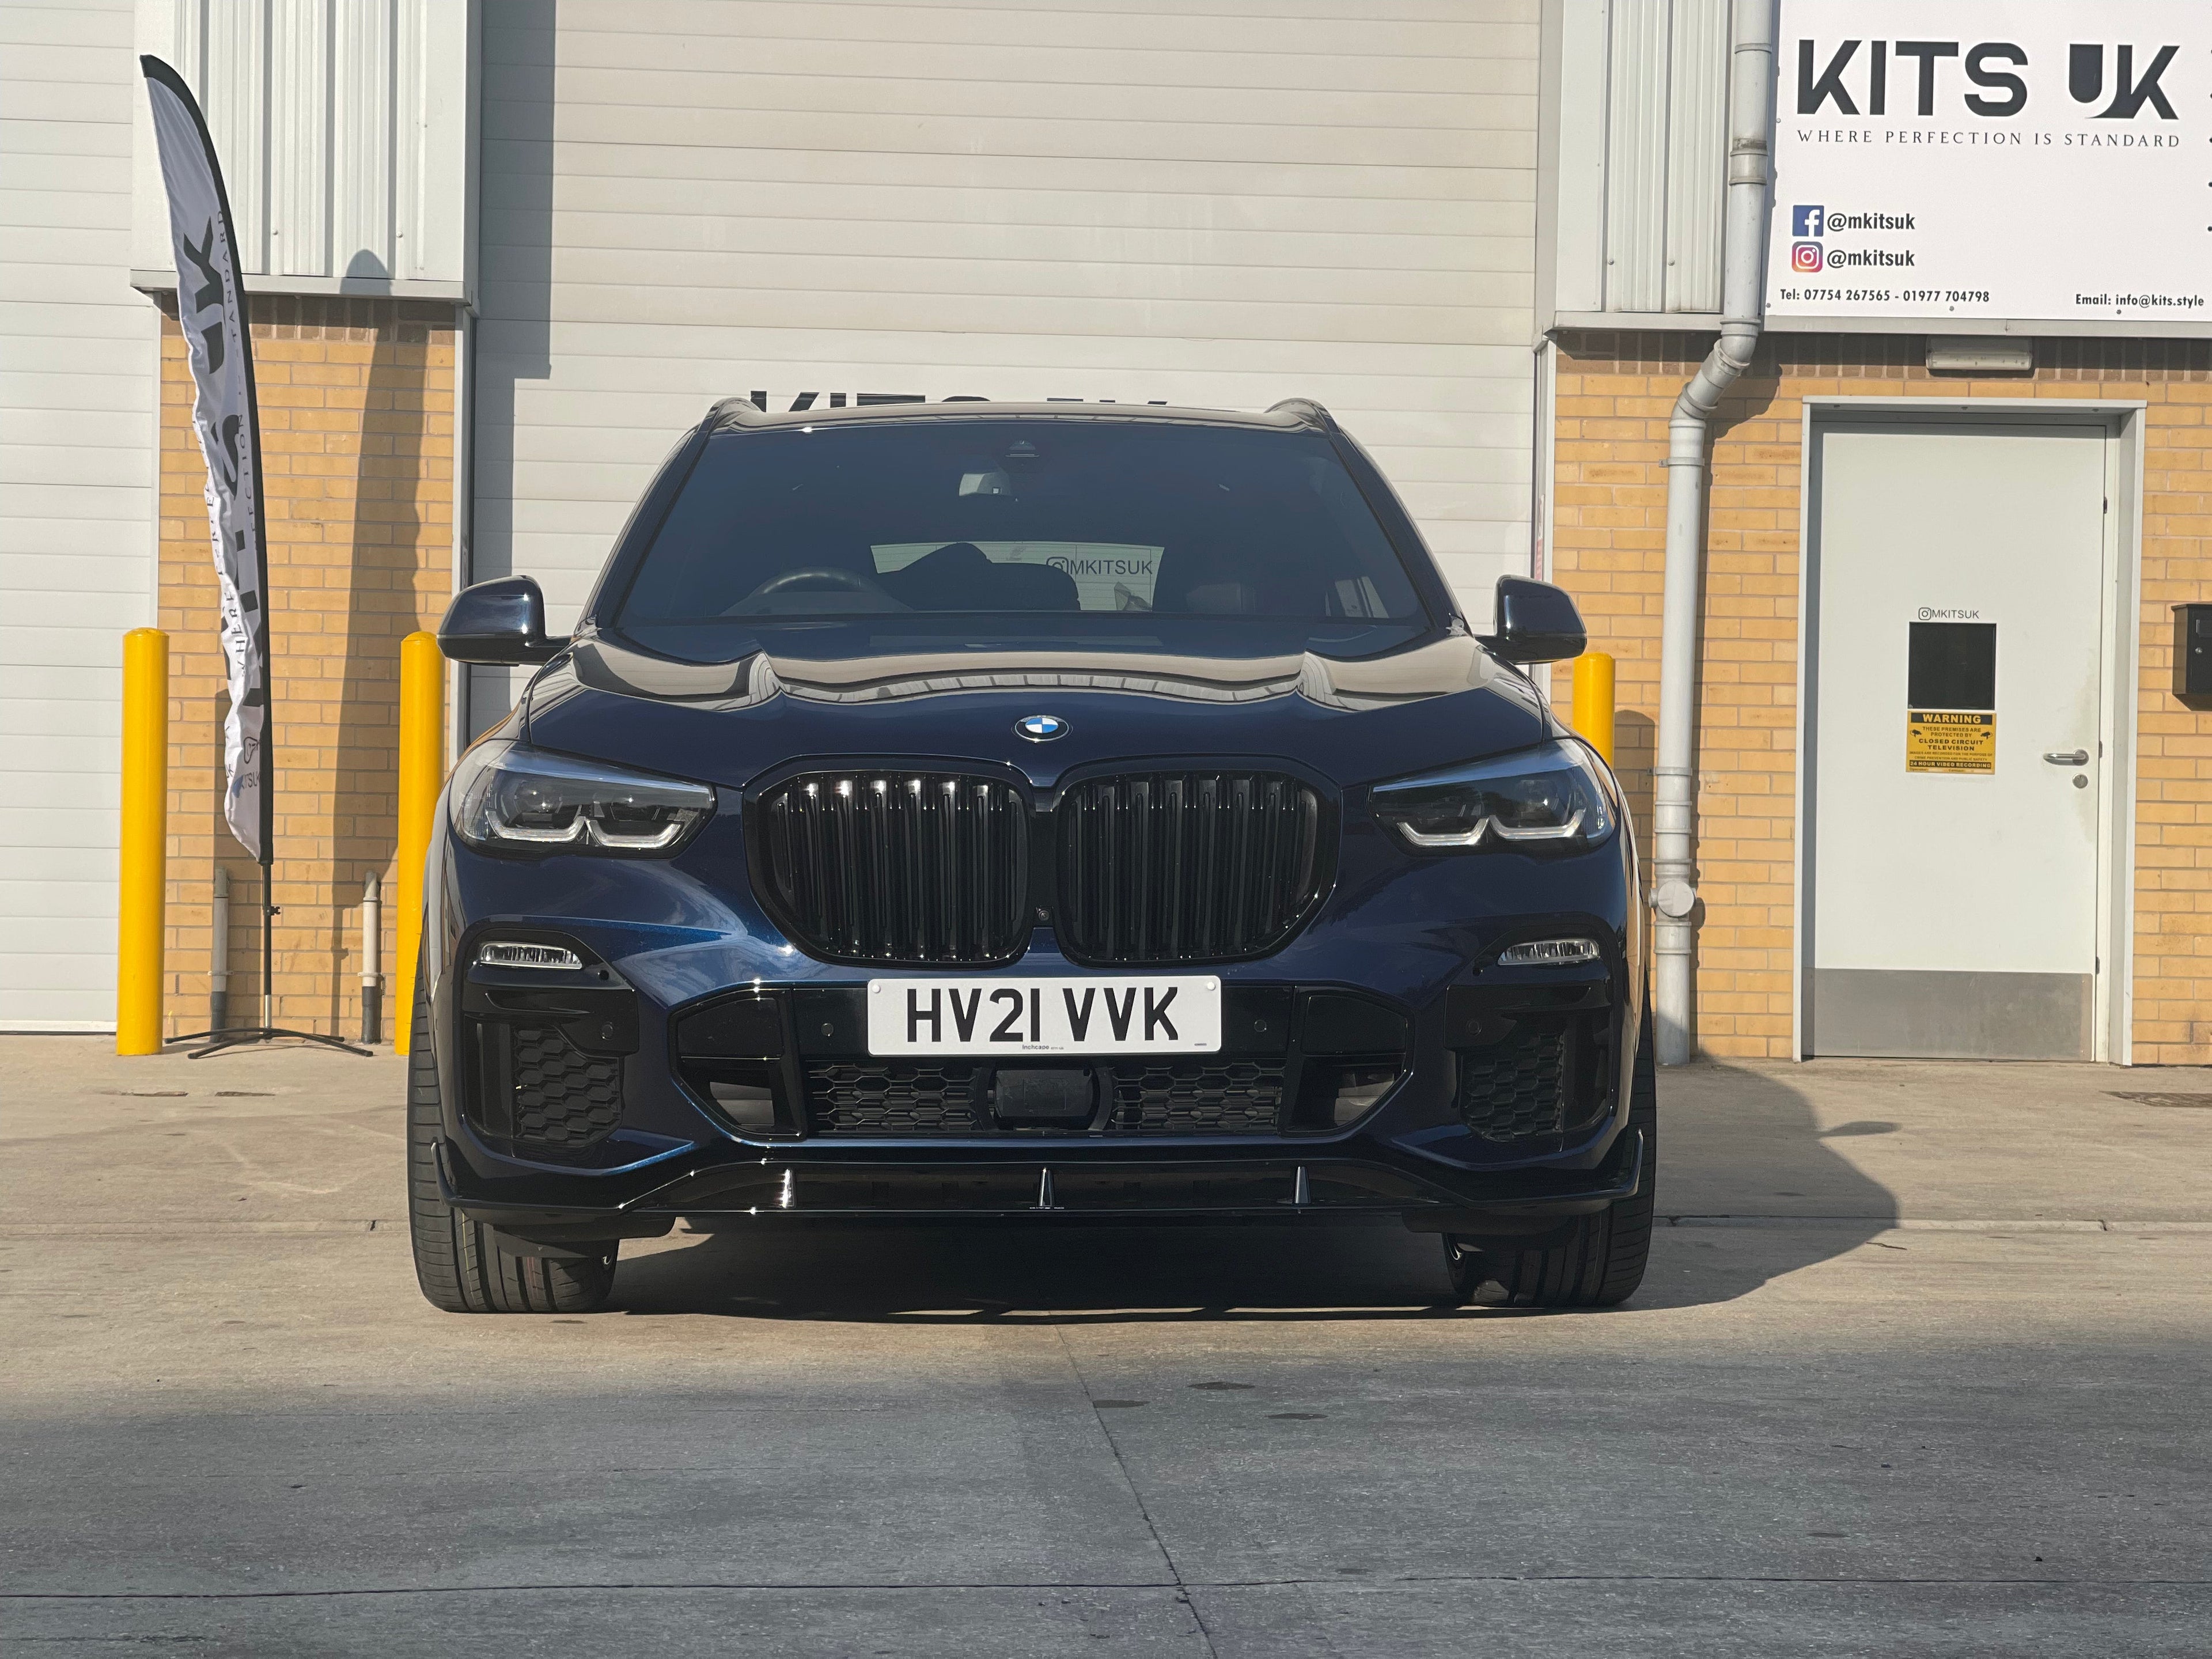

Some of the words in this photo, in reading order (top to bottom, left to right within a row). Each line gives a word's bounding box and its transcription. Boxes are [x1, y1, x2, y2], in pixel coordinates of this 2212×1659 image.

[1796, 39, 2029, 117] KITS
[2068, 43, 2180, 120] UK
[1797, 130, 1873, 143] WHERE
[1885, 131, 2021, 145] PERFECTION
[2034, 132, 2052, 145] IS
[2064, 133, 2180, 147] STANDARD
[1827, 213, 1915, 232] @mkitsuk
[1827, 249, 1915, 269] @mkitsuk
[1781, 289, 1800, 300] Tel:
[1804, 289, 1842, 301] 07754
[1846, 290, 1890, 301] 267565
[1903, 290, 1941, 302] 01977
[1945, 291, 1990, 302] 704798
[2075, 293, 2112, 305] Email:
[2116, 294, 2205, 309] info@kits.style
[1923, 714, 1982, 724] WARNING
[907, 988, 1040, 1043] HV21
[1062, 987, 1179, 1041] VVK
